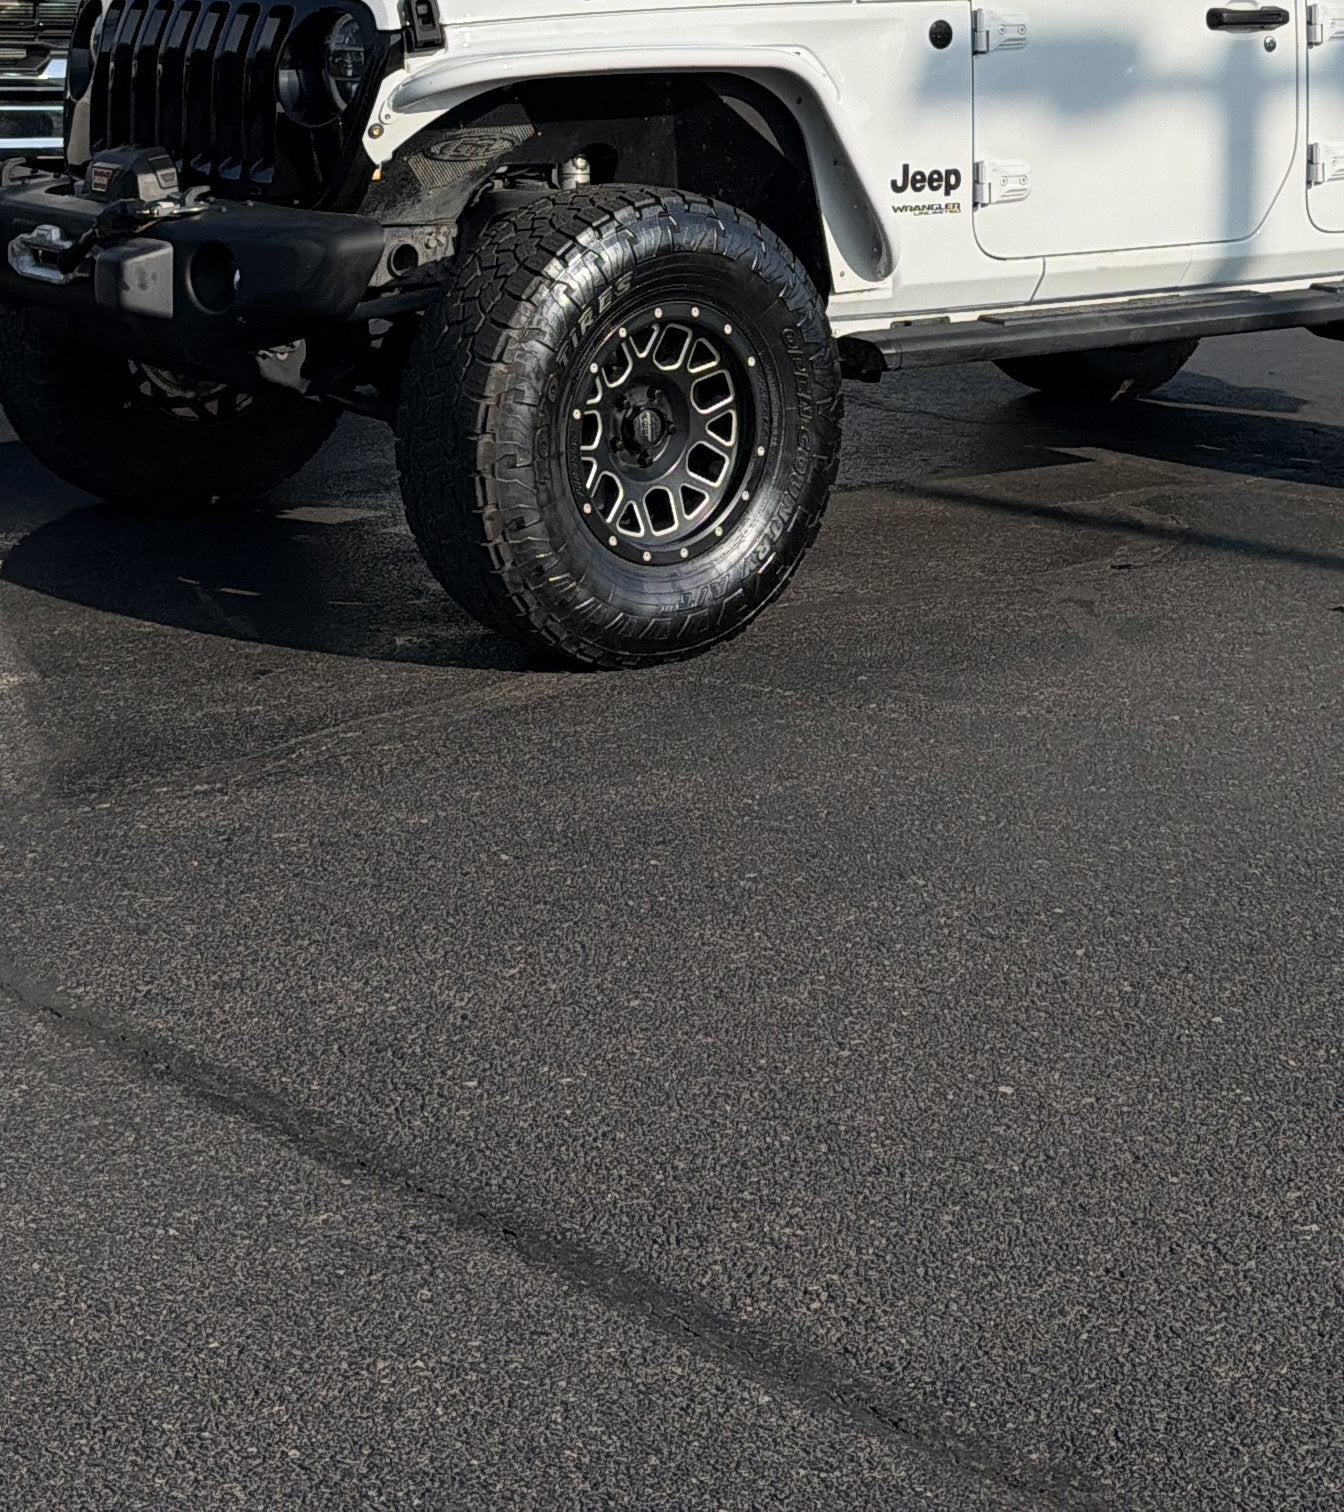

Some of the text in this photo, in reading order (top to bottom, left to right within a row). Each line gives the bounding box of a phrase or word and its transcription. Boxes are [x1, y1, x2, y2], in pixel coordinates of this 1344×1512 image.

[890, 163, 962, 197] Jeep
[891, 202, 961, 214] WRANGLER
[556, 270, 634, 367] TIRES
